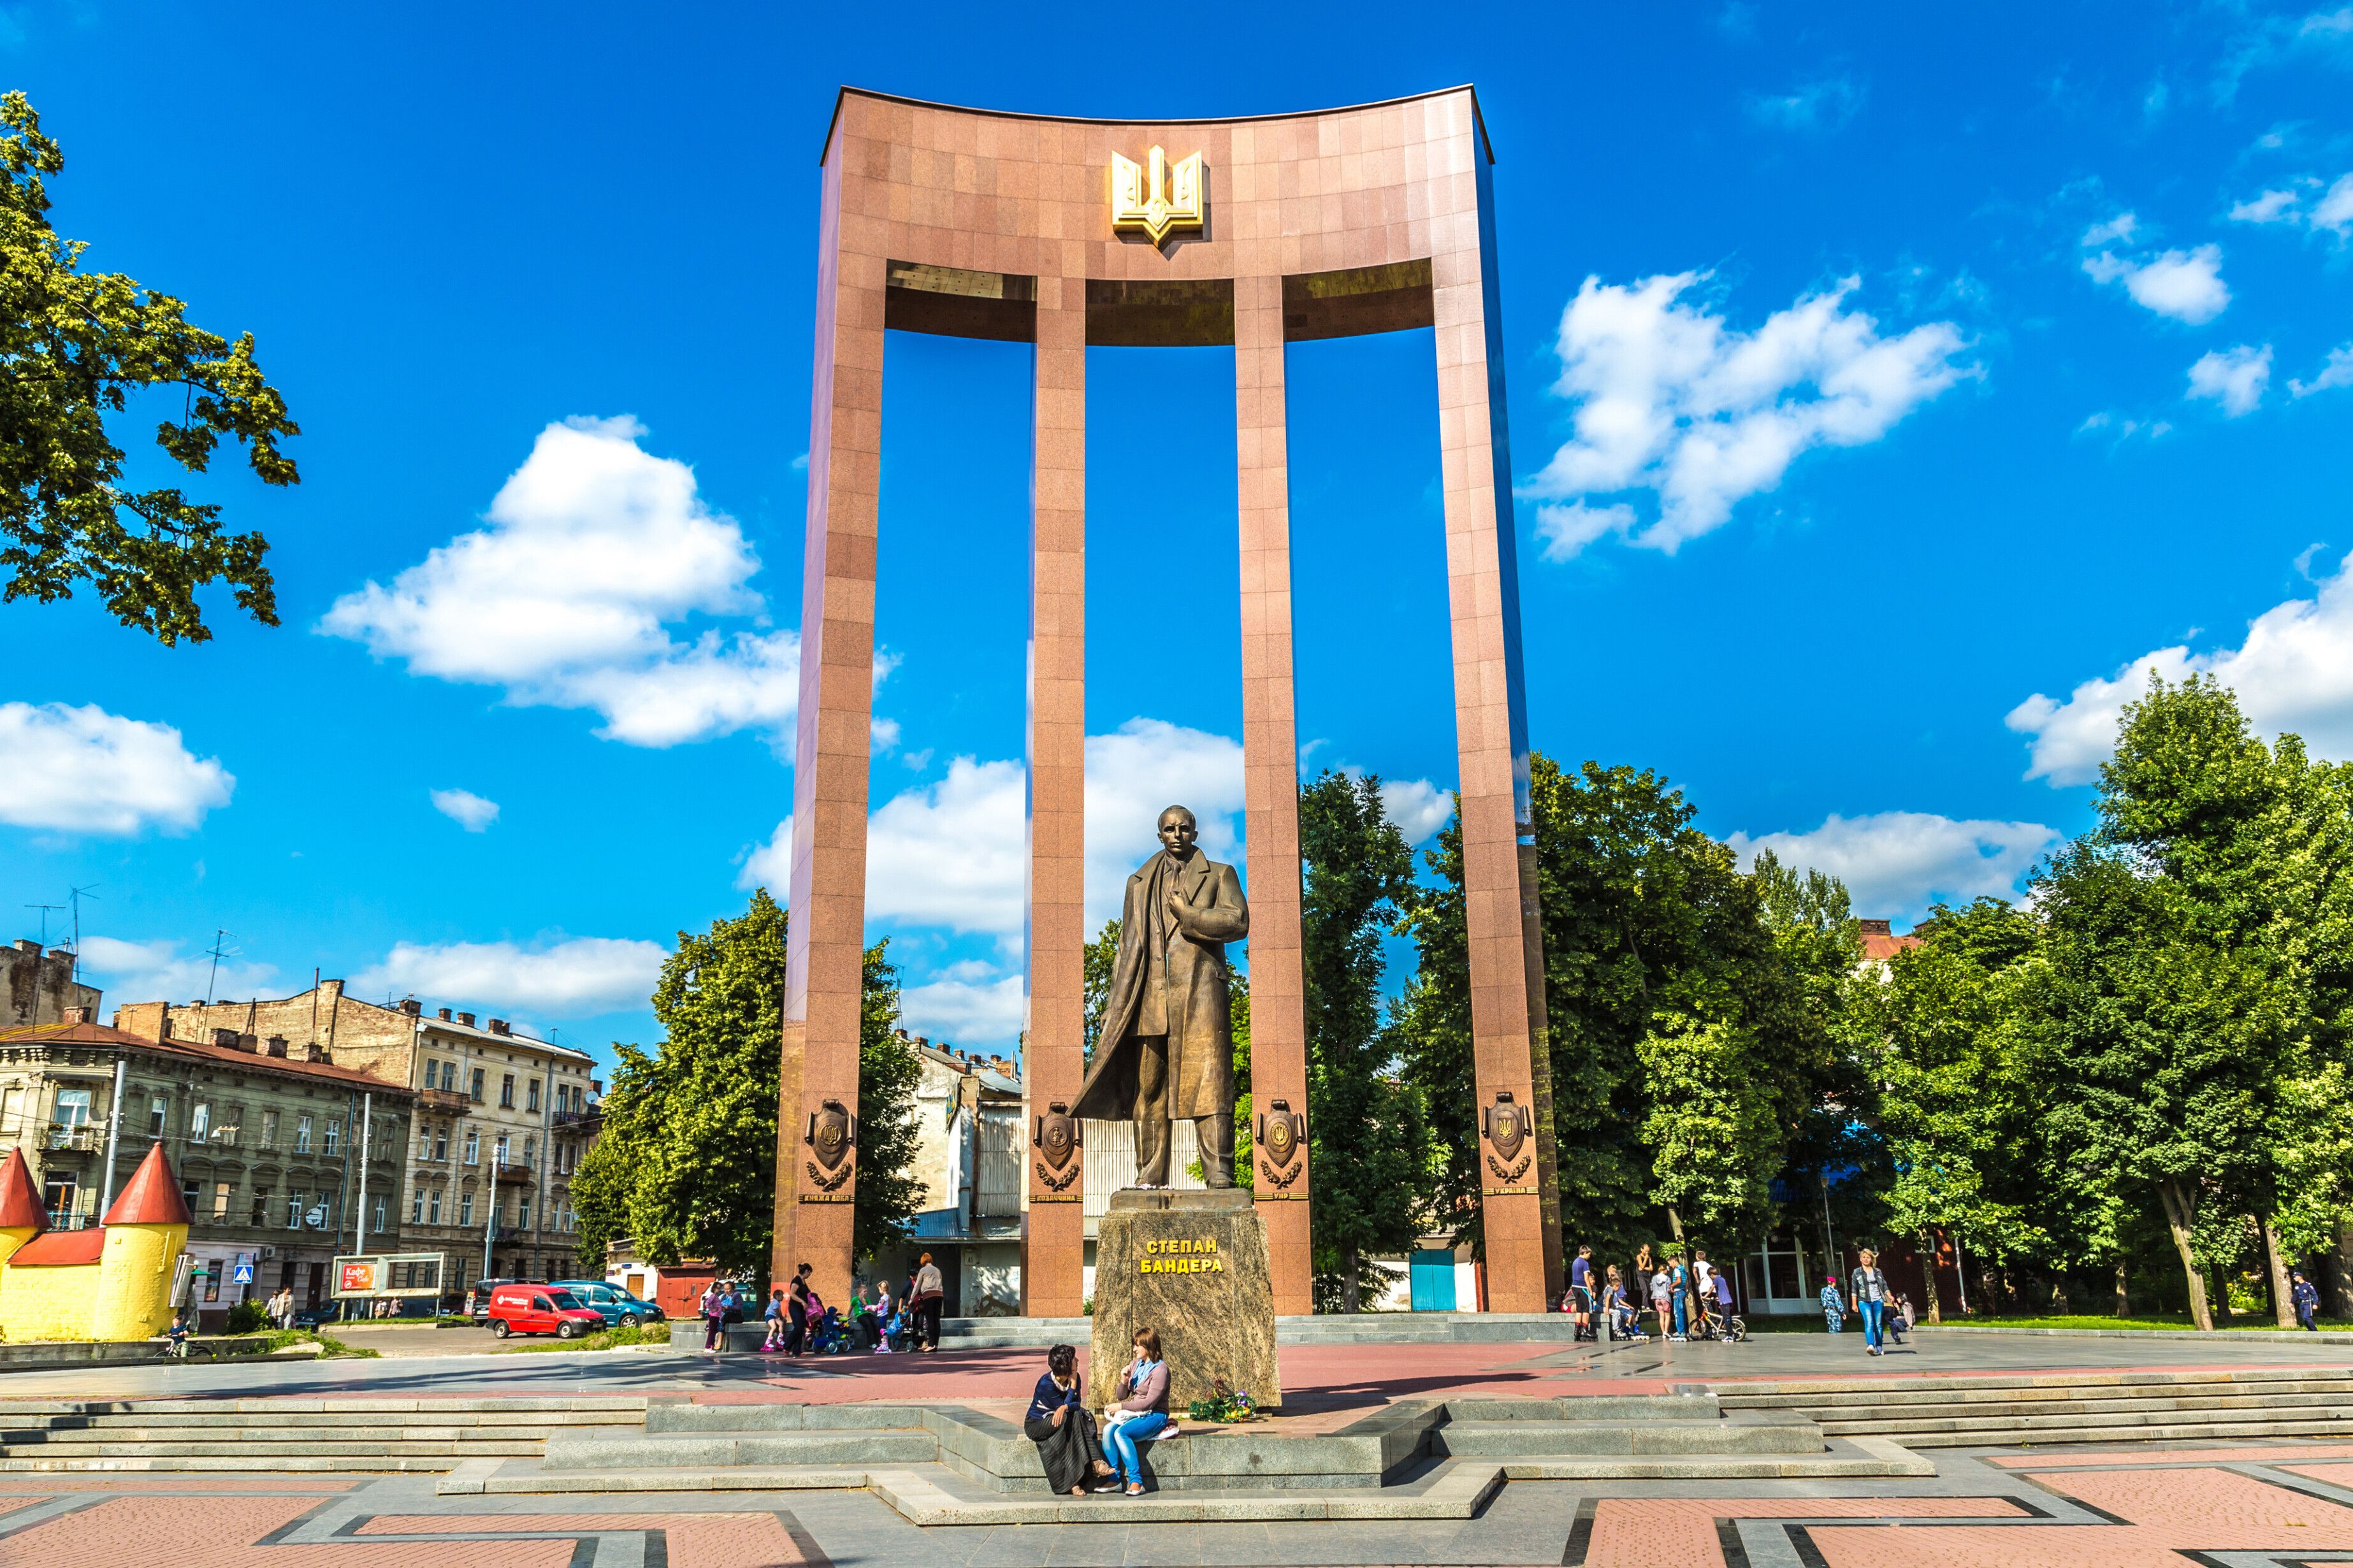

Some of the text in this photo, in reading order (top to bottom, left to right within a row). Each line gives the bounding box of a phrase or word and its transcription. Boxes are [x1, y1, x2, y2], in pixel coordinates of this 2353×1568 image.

[1147, 1240, 1217, 1254] СТЕПАН
[346, 1267, 365, 1277] Кафе
[1140, 1259, 1223, 1274] БАНДЕРА
